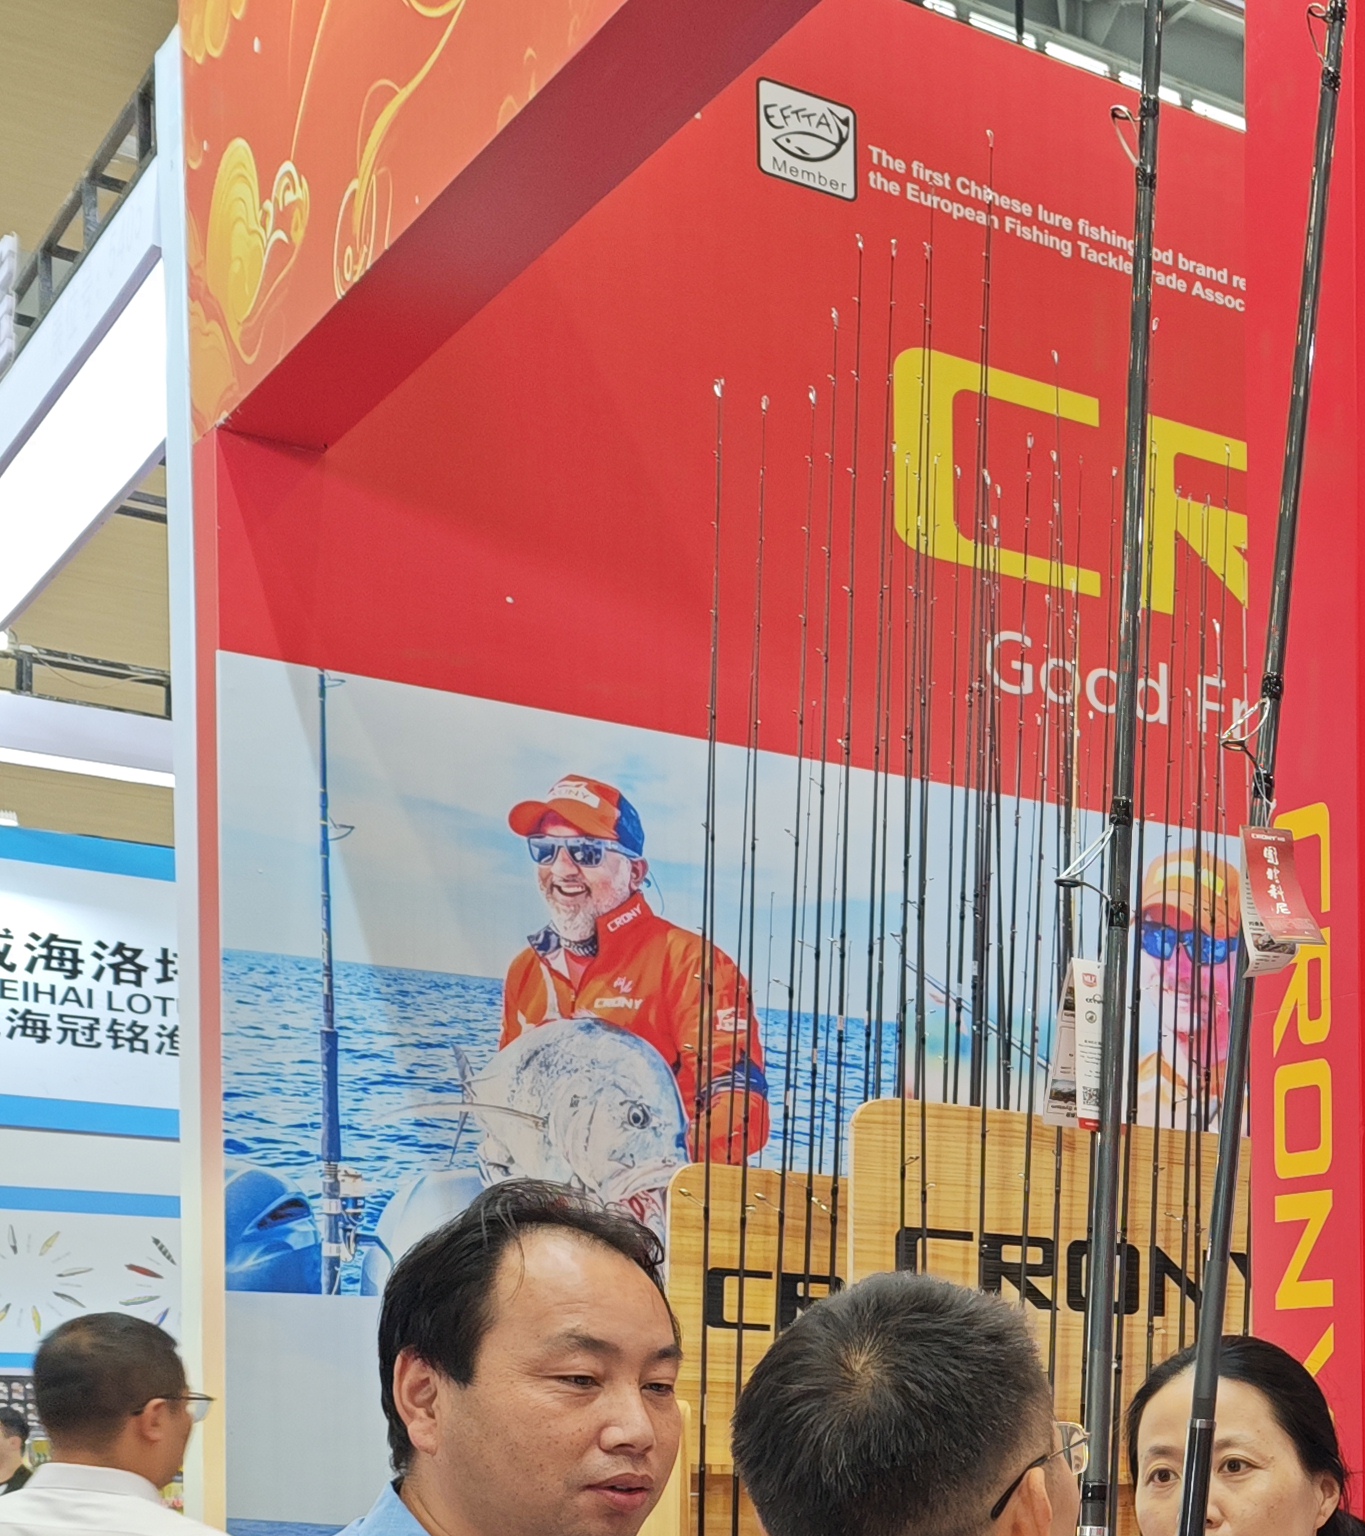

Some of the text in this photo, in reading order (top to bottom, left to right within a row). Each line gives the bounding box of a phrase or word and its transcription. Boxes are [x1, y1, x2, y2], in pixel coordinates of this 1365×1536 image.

[763, 103, 833, 134] EFTTA
[772, 156, 847, 193] Member
[868, 145, 906, 173] The
[911, 160, 951, 190] first
[956, 177, 1033, 217] Chinese
[1038, 204, 1073, 231] lure
[1077, 218, 1135, 257] fishing
[1177, 252, 1228, 285] brand
[1232, 274, 1247, 291] re
[868, 171, 1246, 312] the European Fishing Tackle rade Assoc
[607, 903, 643, 933] CRONY
[0, 979, 179, 1018] EIHAI LOT
[594, 997, 643, 1010] CRONY
